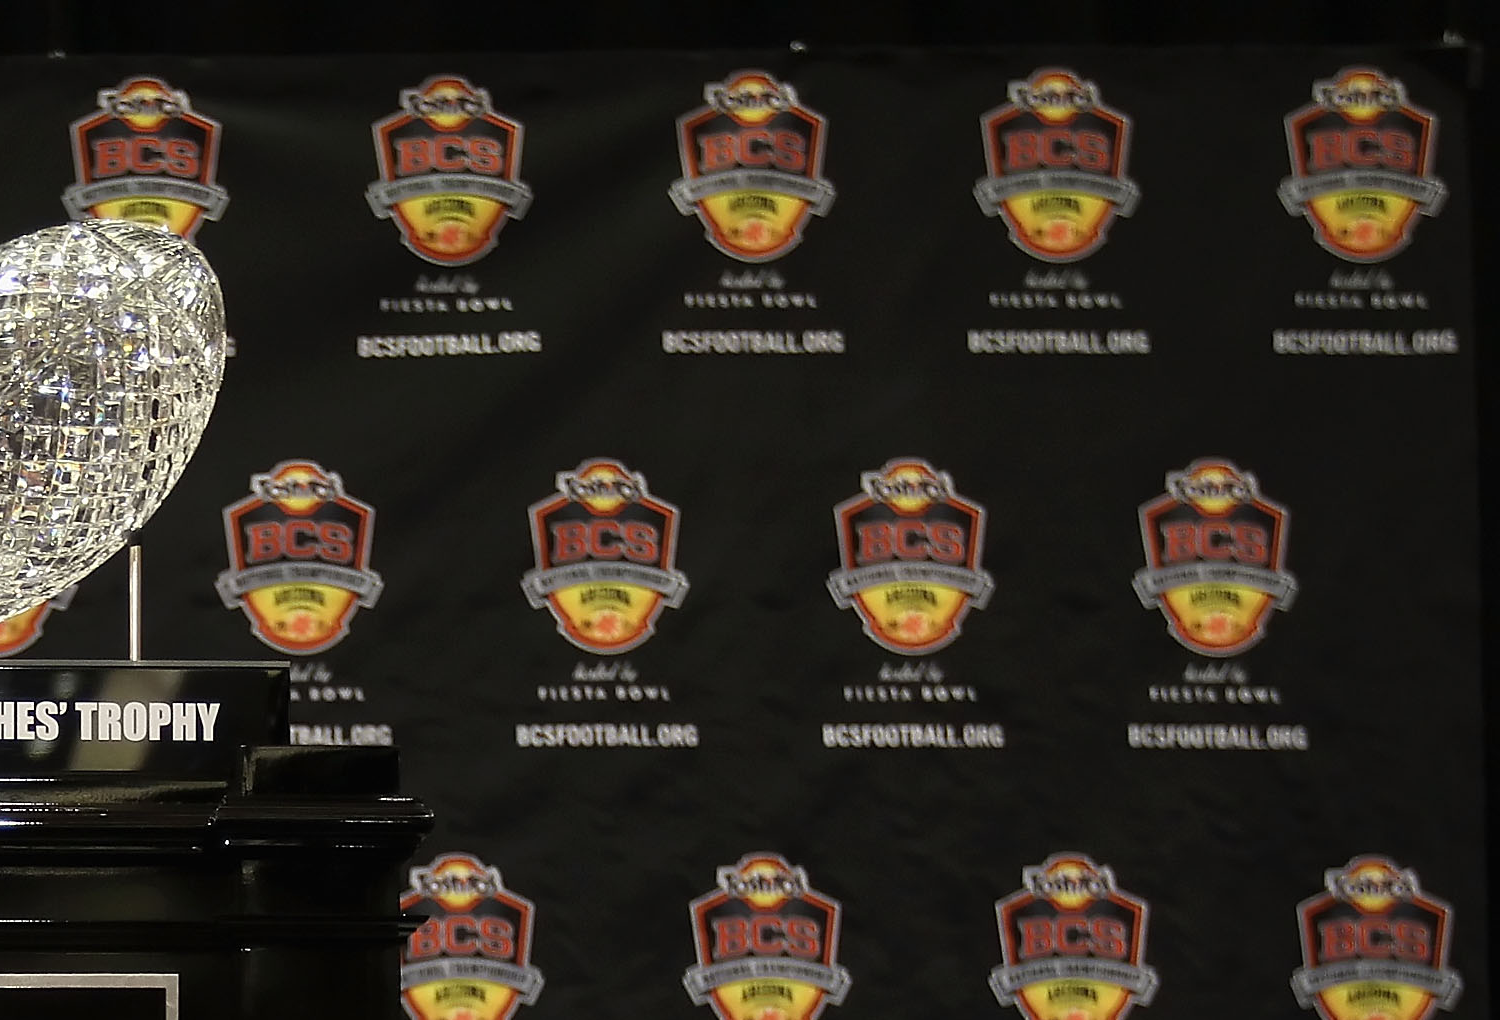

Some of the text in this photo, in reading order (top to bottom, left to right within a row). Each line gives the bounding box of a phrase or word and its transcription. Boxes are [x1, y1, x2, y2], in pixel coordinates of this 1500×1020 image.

[95, 136, 200, 176] BCS
[398, 135, 502, 174] BCS
[701, 130, 806, 170] BCS
[249, 519, 353, 562] BCS
[554, 519, 658, 562] BCS
[860, 519, 965, 562] BCS
[1165, 518, 1267, 563] BCS
[80, 702, 221, 742] TROPHY
[409, 915, 514, 959] BCS
[715, 913, 820, 958] BCS
[1019, 915, 1127, 958] BCS
[1322, 918, 1430, 961] BCS
